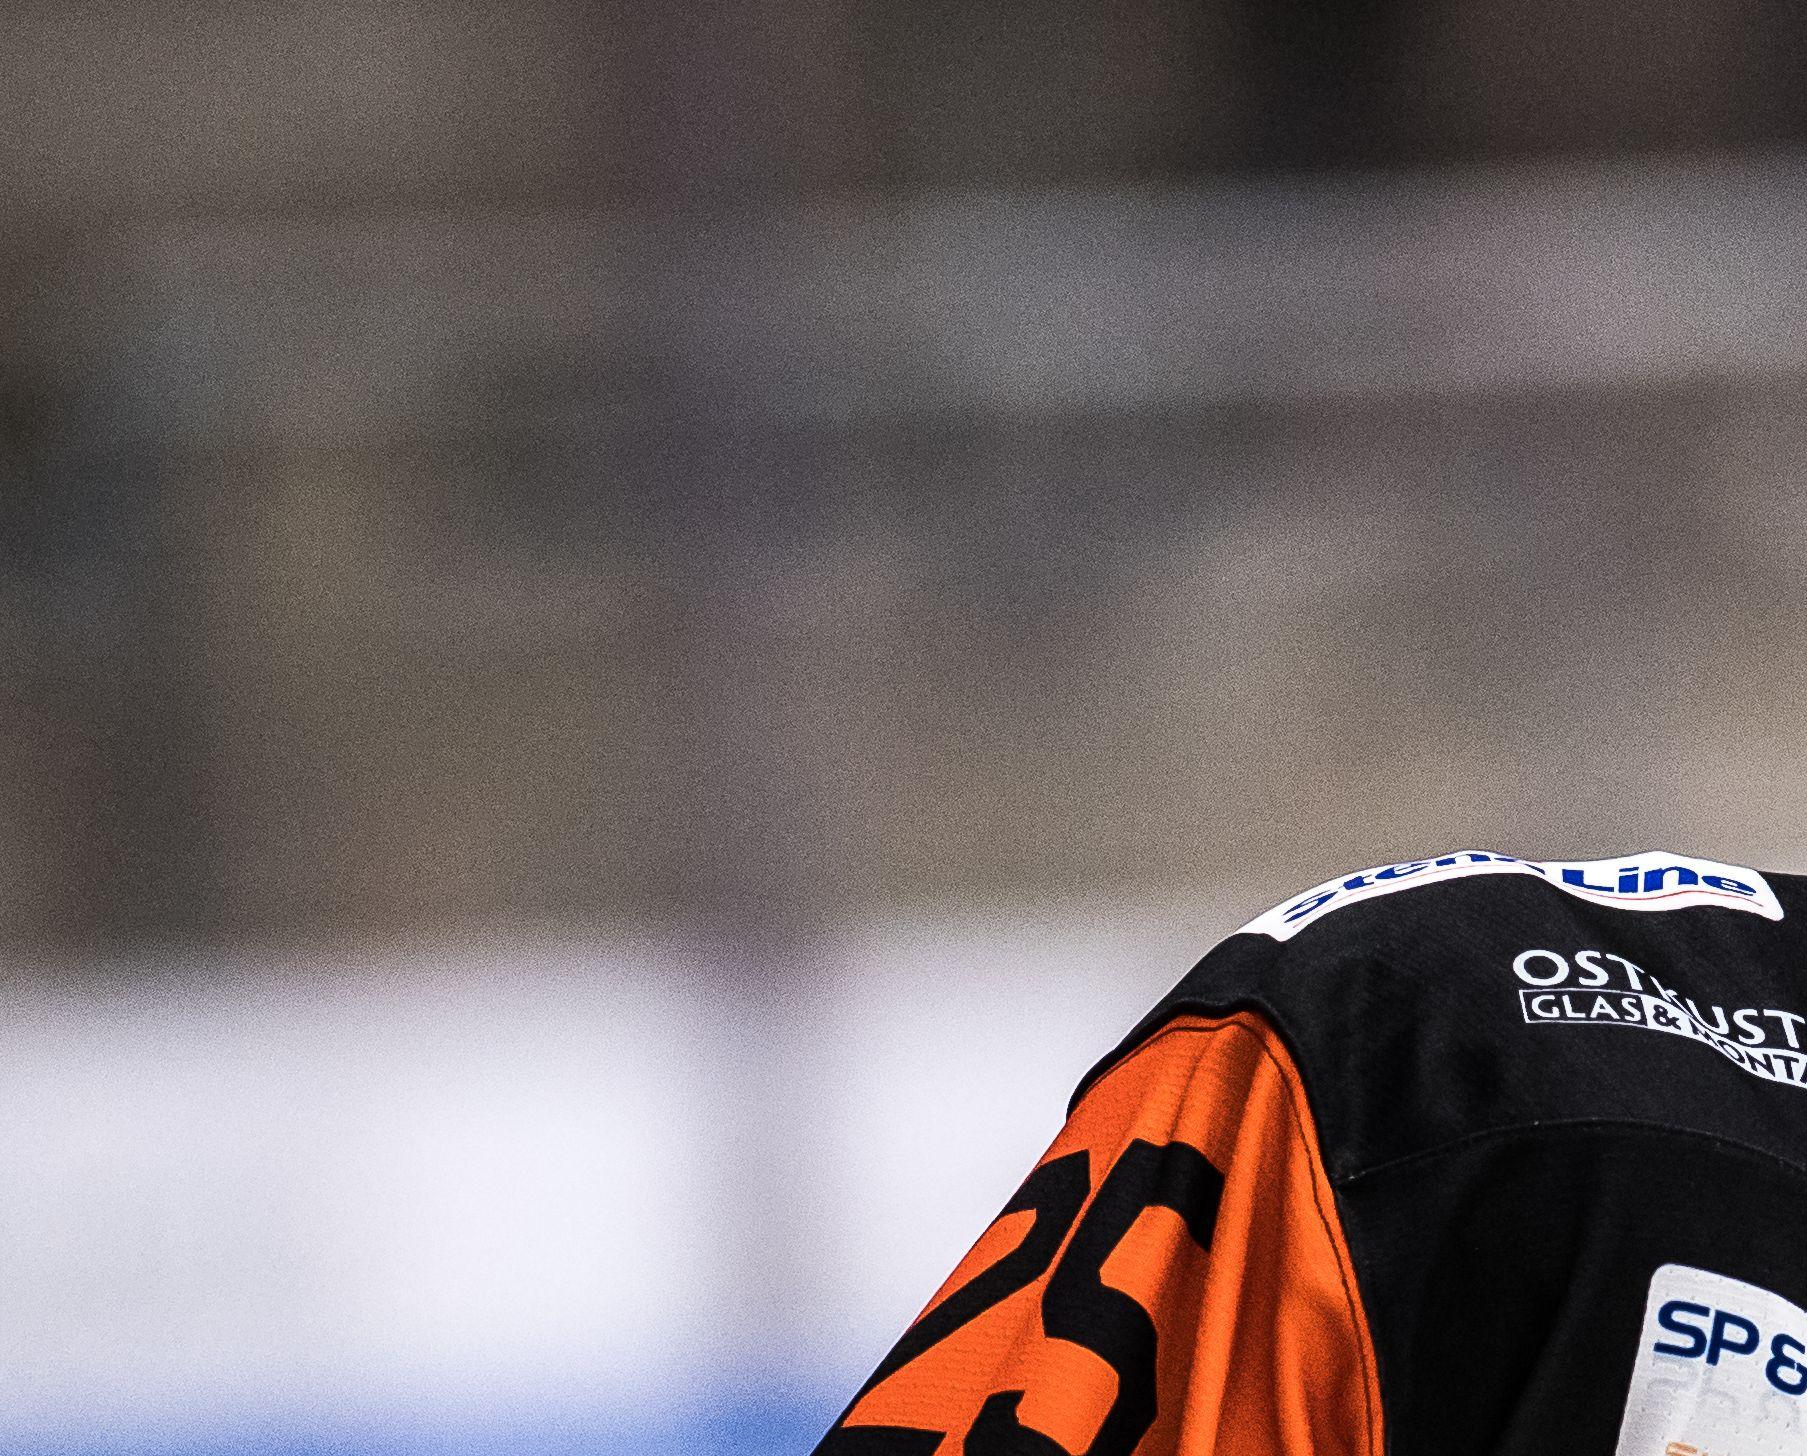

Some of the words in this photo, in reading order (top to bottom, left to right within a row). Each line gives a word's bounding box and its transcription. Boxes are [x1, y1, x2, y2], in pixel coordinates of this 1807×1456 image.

[1561, 863, 1756, 896] Line
[1531, 994, 1637, 1021] GLAS
[1652, 1004, 1682, 1028] &
